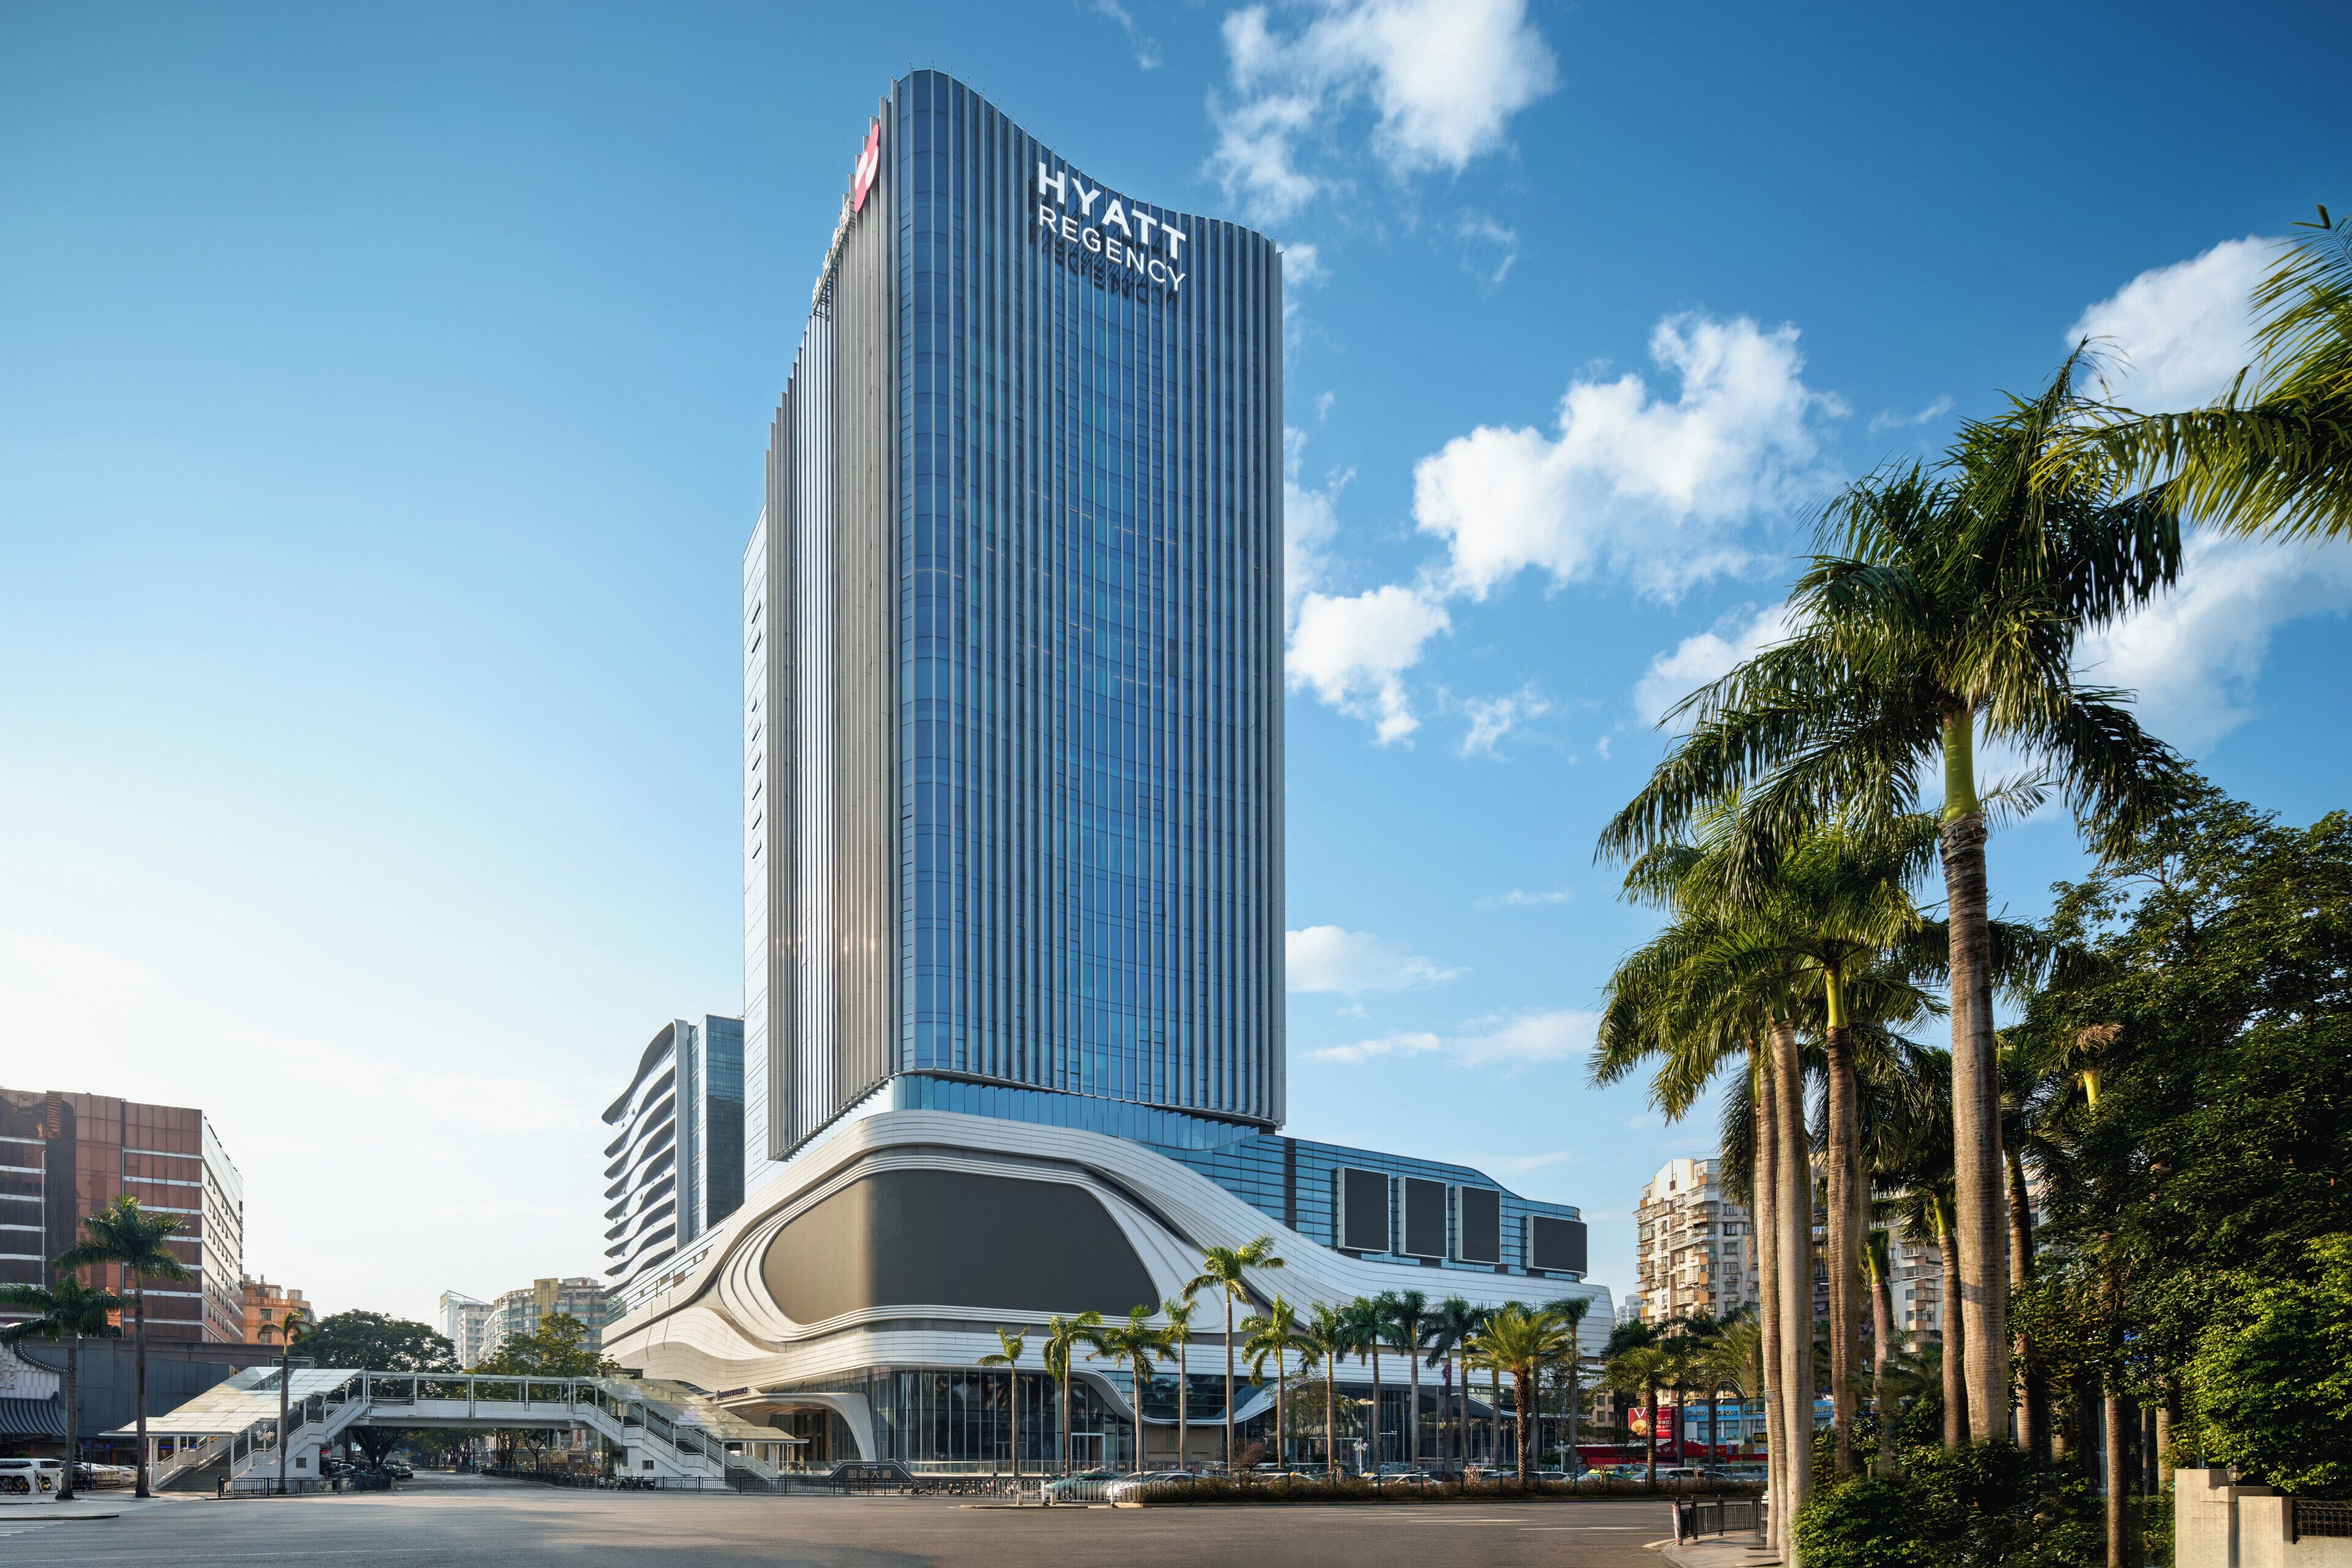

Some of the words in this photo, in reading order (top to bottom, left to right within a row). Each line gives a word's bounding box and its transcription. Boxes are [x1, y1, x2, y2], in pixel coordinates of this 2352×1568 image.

[1039, 161, 1186, 260] HYATT
[1039, 204, 1186, 292] REGENCY
[848, 1469, 892, 1479] 国际大厦
